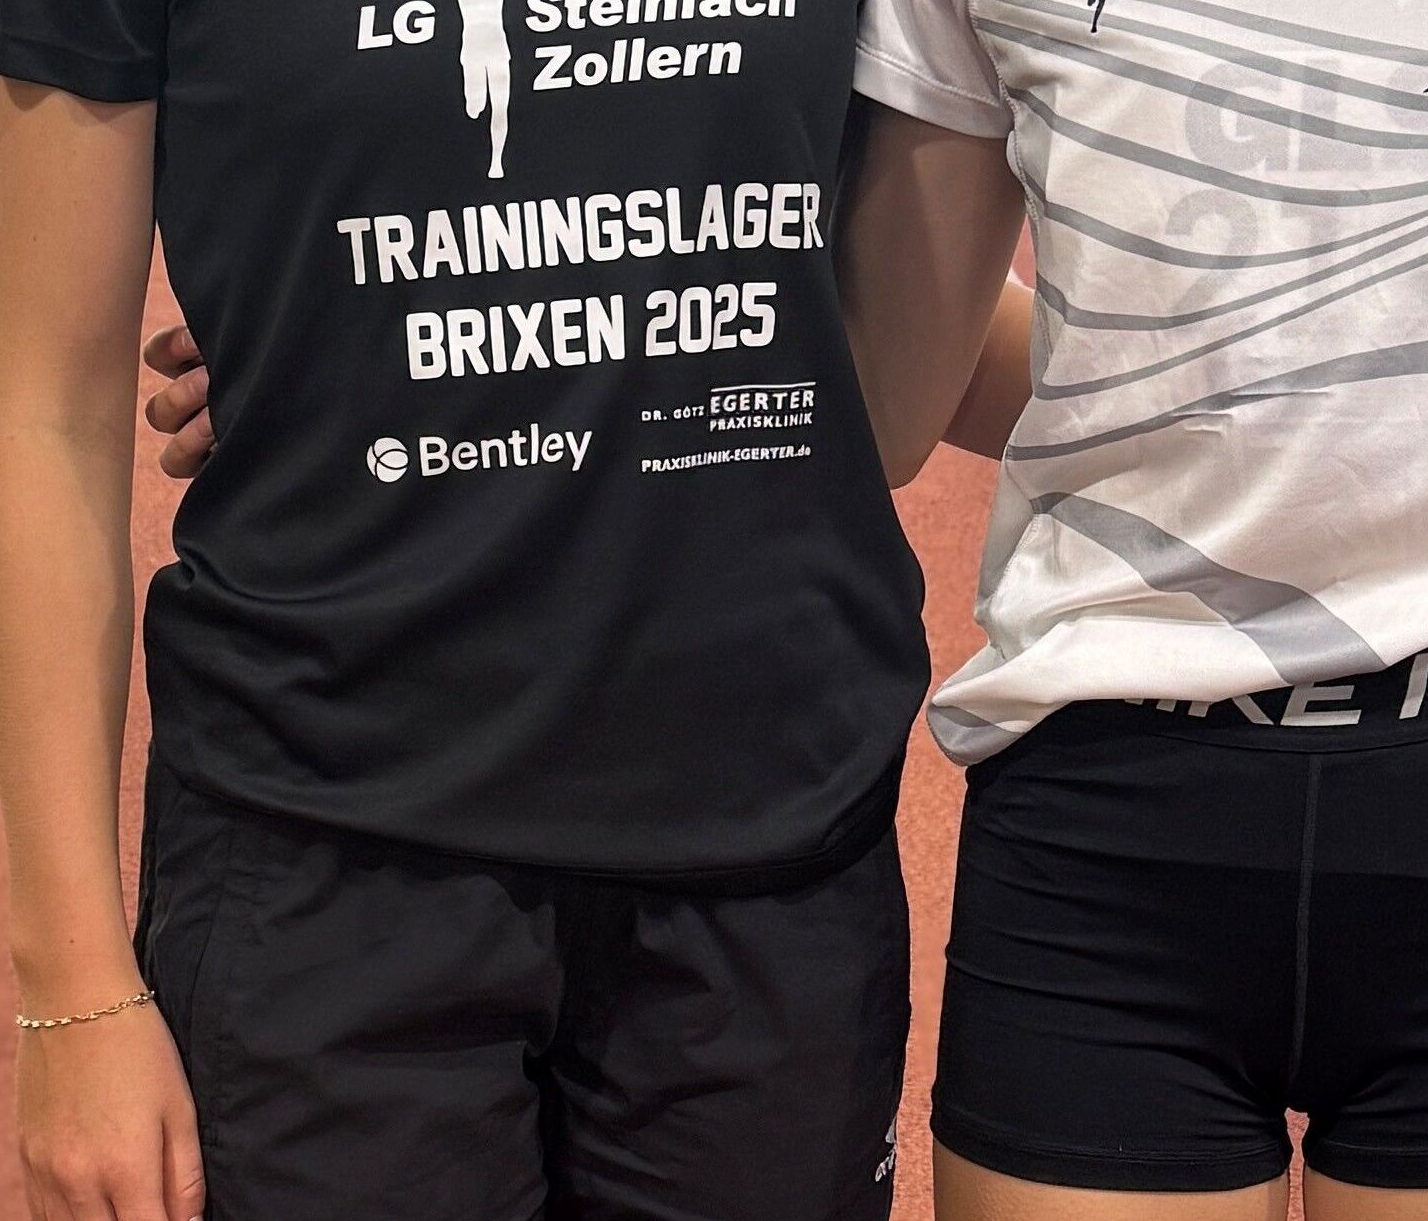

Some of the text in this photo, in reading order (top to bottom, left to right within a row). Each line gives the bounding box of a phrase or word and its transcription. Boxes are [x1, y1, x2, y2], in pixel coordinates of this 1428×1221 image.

[357, 1, 435, 50] LG
[532, 37, 741, 91] Zollern
[337, 182, 824, 285] TRAININGSLAGER
[406, 281, 777, 380] BRIXEN 2025
[641, 409, 668, 422] DR.
[710, 389, 814, 414] EGERTER
[709, 412, 813, 432] PRAXISKLINIK
[419, 423, 593, 478] Bentley
